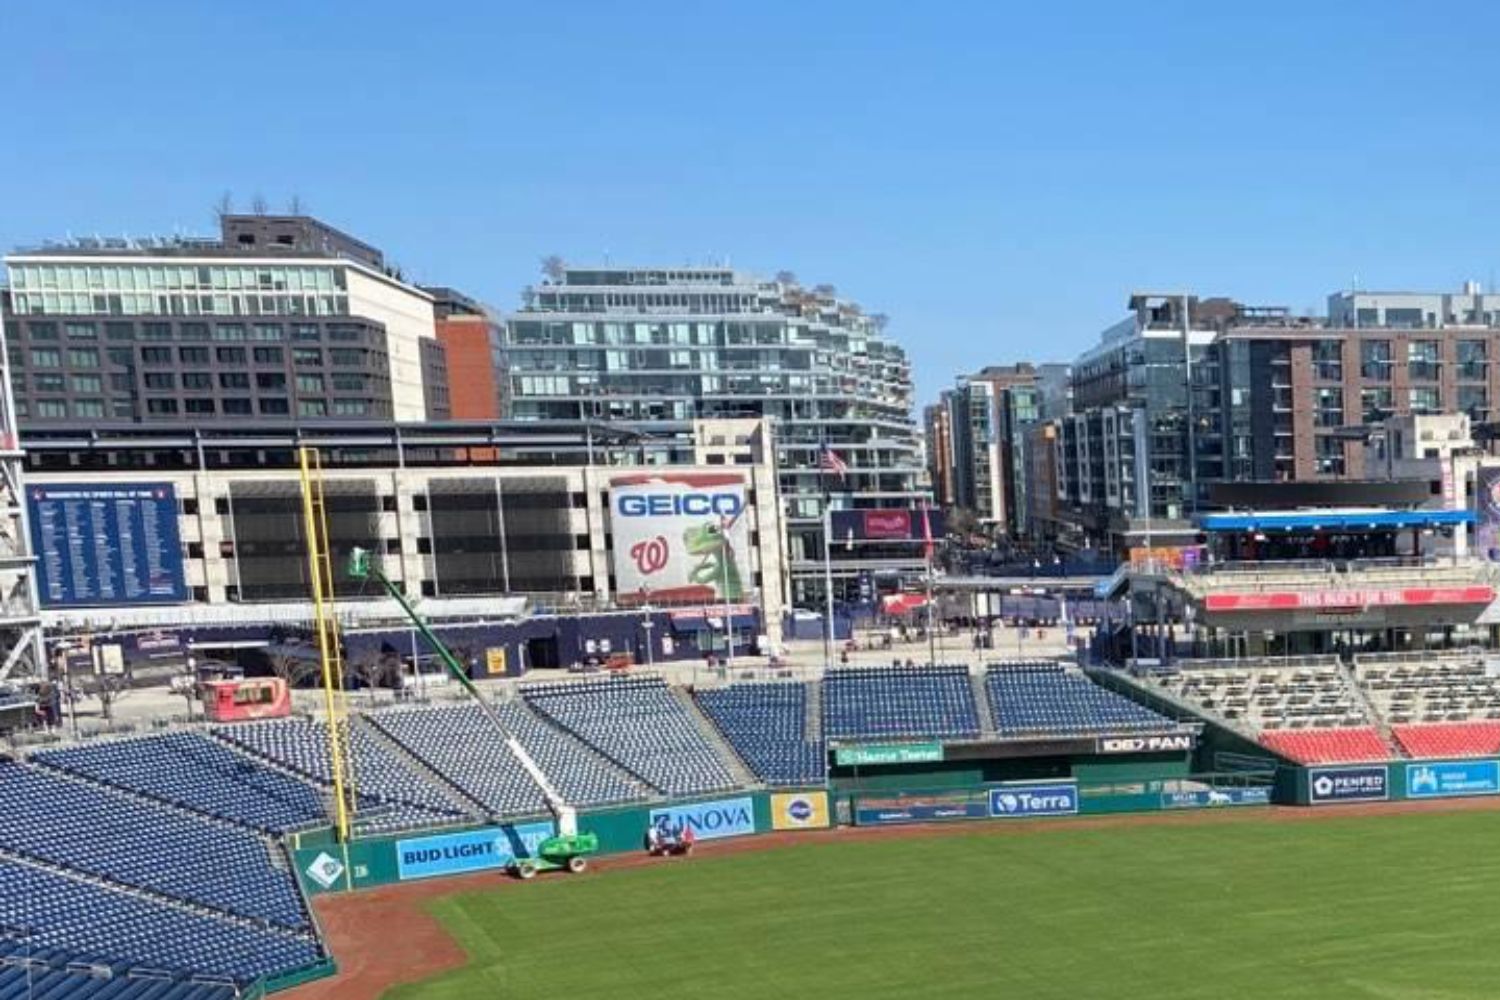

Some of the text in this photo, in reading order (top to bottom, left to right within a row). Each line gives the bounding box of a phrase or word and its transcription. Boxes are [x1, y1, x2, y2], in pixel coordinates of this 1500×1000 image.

[618, 493, 741, 517] GEICO
[1149, 736, 1190, 750] FAN
[1019, 792, 1071, 810] Terra
[403, 848, 442, 865] BUD
[446, 841, 495, 861] LIGHT
